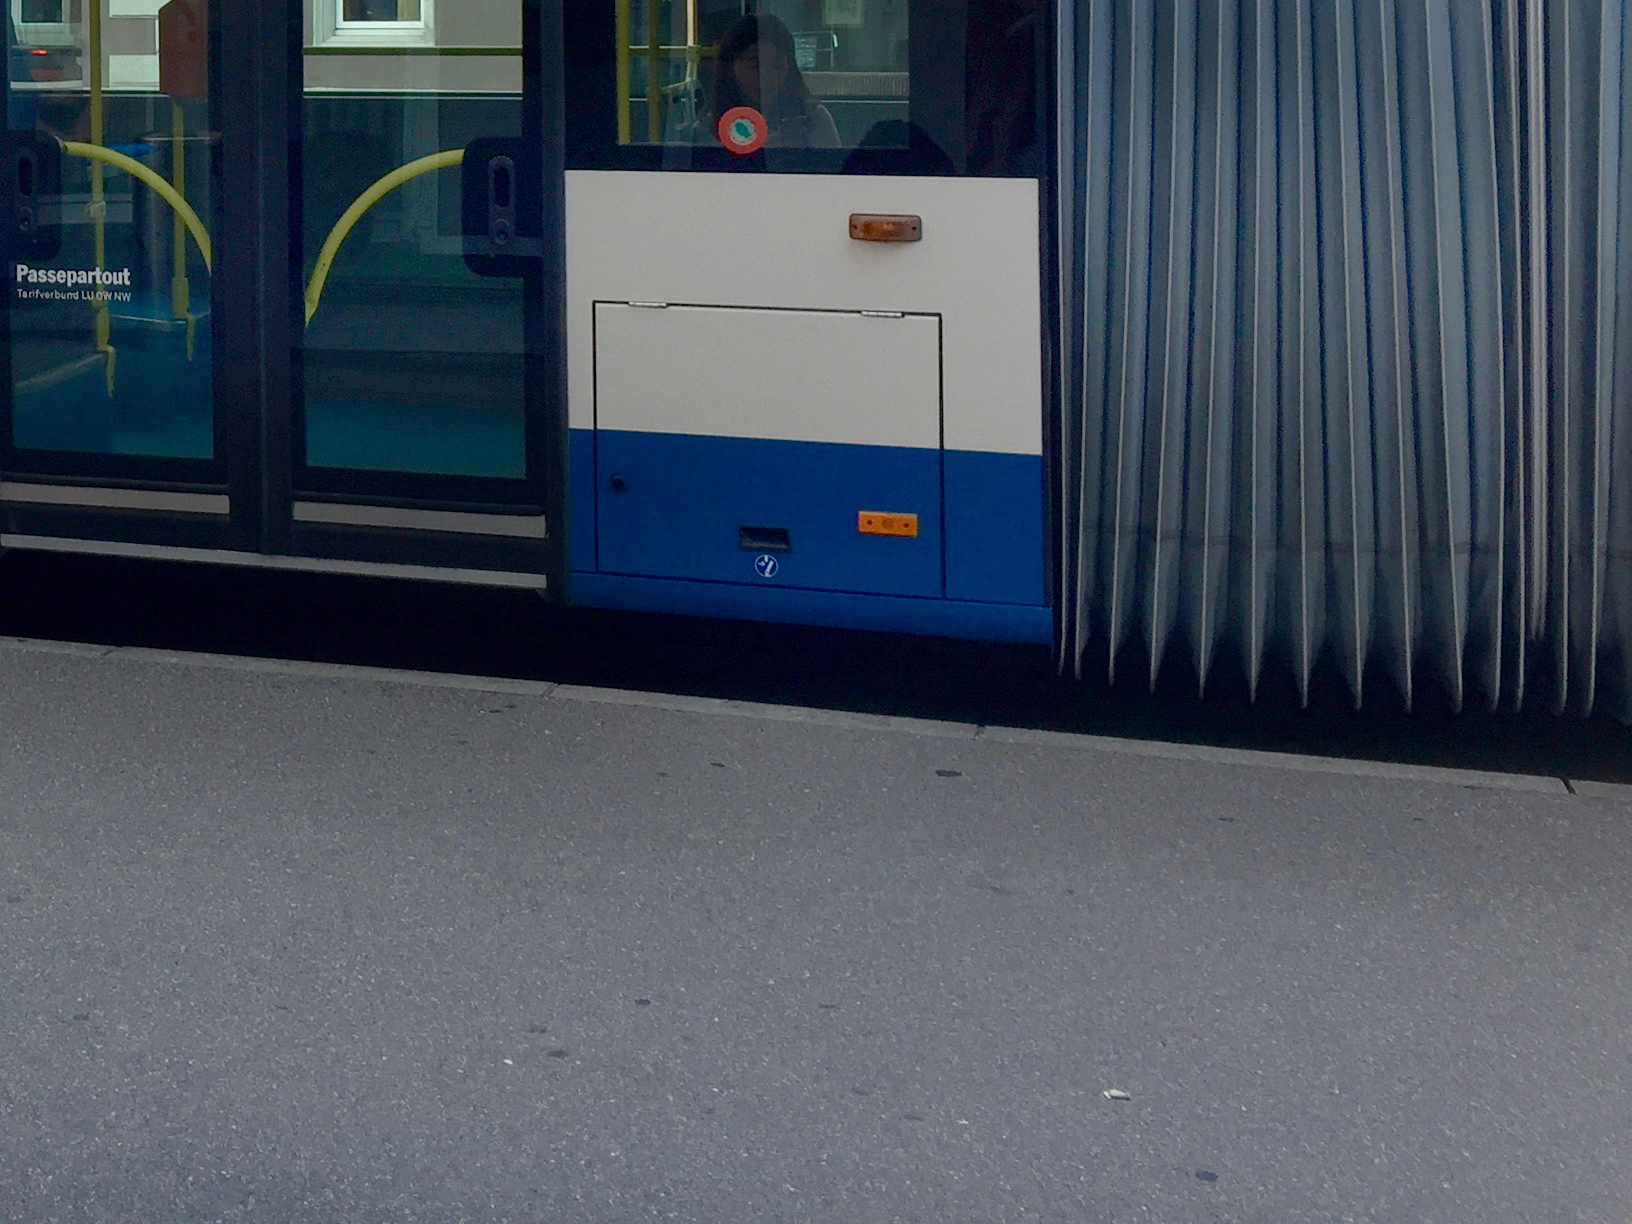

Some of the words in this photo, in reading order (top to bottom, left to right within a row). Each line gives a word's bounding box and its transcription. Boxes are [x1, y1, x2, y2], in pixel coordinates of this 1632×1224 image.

[16, 264, 131, 287] Passepartout
[17, 288, 79, 301] Tarifverbund
[81, 290, 94, 301] LU
[96, 290, 113, 301] OW
[114, 292, 132, 303] NW
